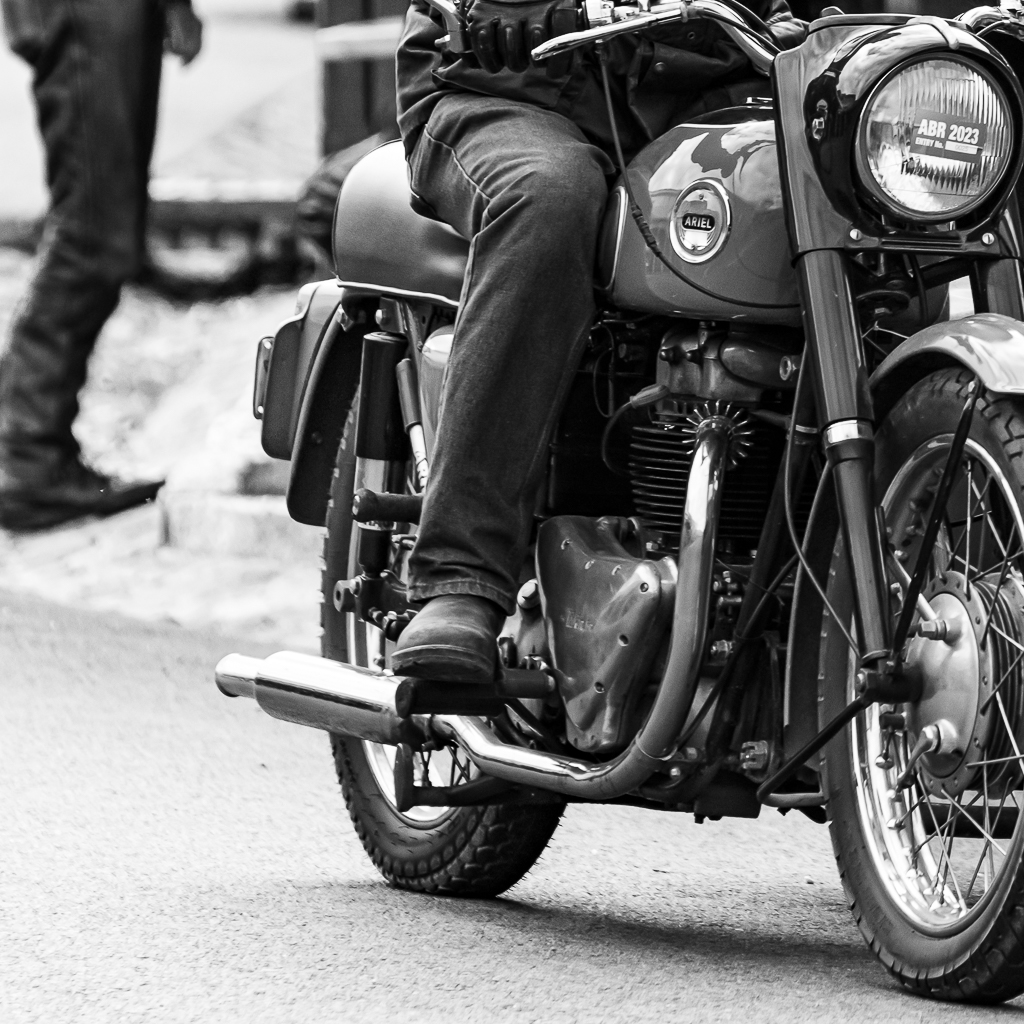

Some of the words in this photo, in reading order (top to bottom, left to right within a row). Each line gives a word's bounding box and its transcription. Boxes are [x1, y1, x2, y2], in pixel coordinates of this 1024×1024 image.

[917, 118, 947, 138] ABR
[948, 124, 980, 144] 2023
[684, 215, 712, 229] ARIEL
